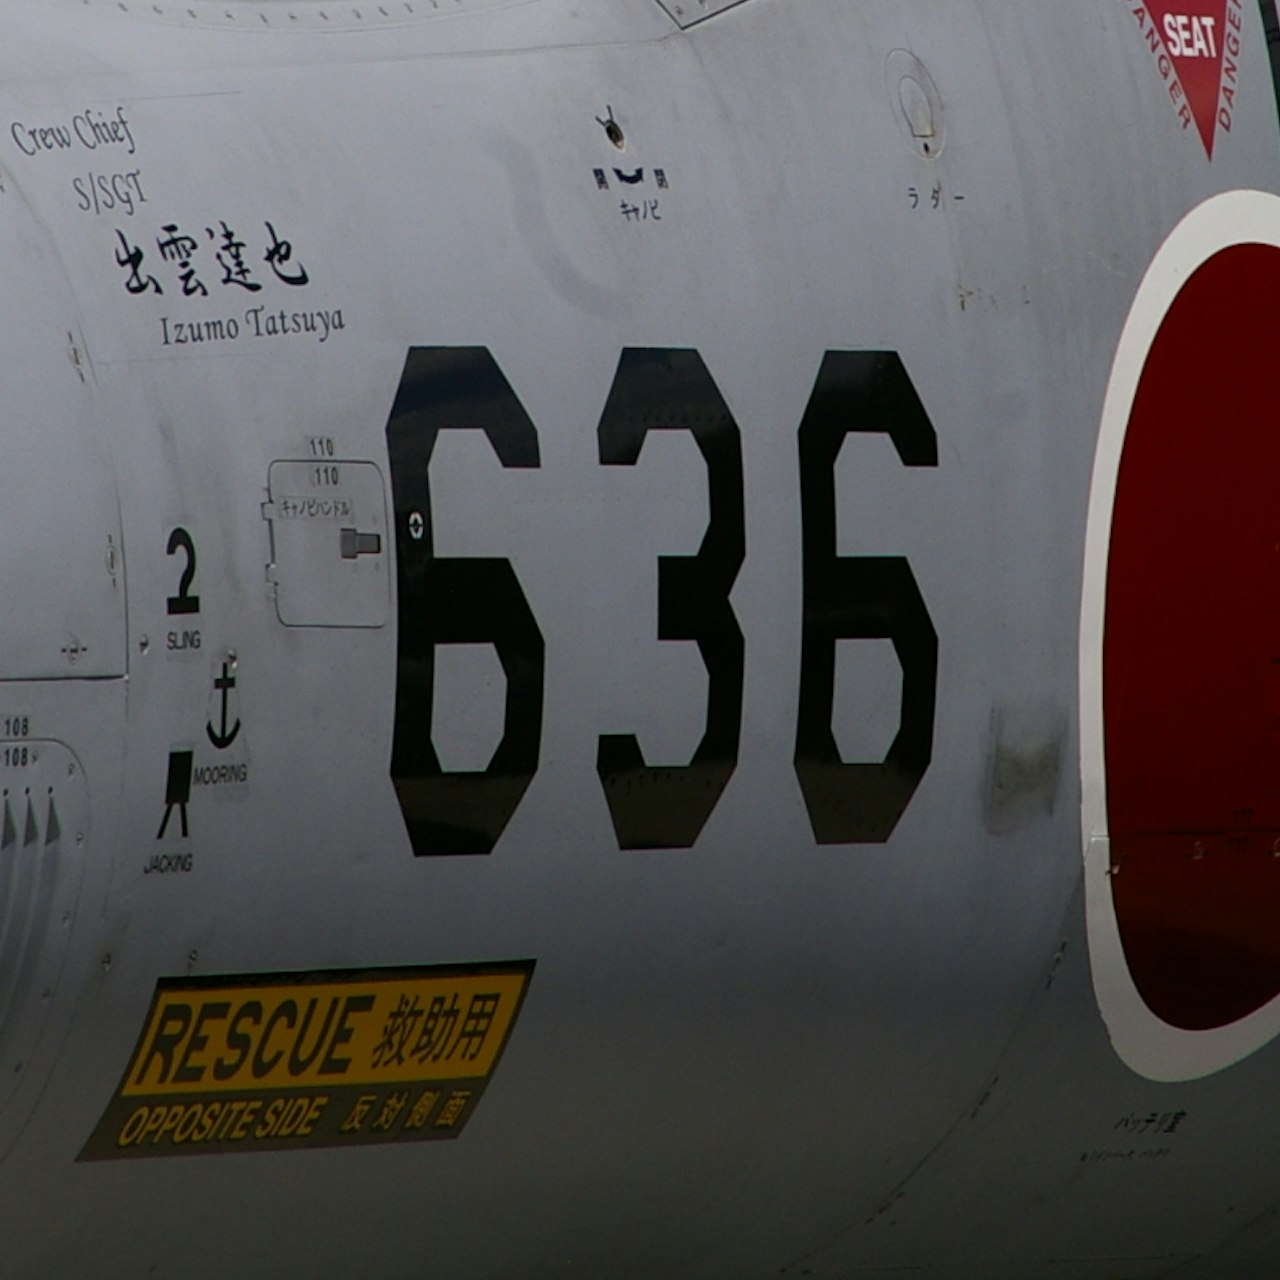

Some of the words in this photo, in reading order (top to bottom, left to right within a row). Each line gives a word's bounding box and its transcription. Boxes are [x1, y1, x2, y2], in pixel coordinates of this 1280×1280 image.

[1162, 12, 1218, 59] SEAT
[11, 120, 70, 156] Crew
[73, 106, 136, 154] Chief
[73, 170, 148, 216] S/SGT
[114, 220, 309, 296] 出雲達也
[160, 317, 240, 346] Izumo
[244, 305, 346, 343] Tatsuya
[310, 438, 334, 457] 110
[314, 466, 339, 486] 110
[385, 345, 939, 857] 636
[166, 631, 202, 651] SLING
[4, 717, 29, 737] 108
[4, 746, 28, 768] 108
[193, 764, 248, 785] MOORING
[143, 854, 193, 875] JACKING
[134, 994, 376, 1086] RESCUE
[371, 992, 501, 1069] 救助用
[116, 1100, 261, 1148] OPPOSITE
[253, 1095, 329, 1137] SIDE
